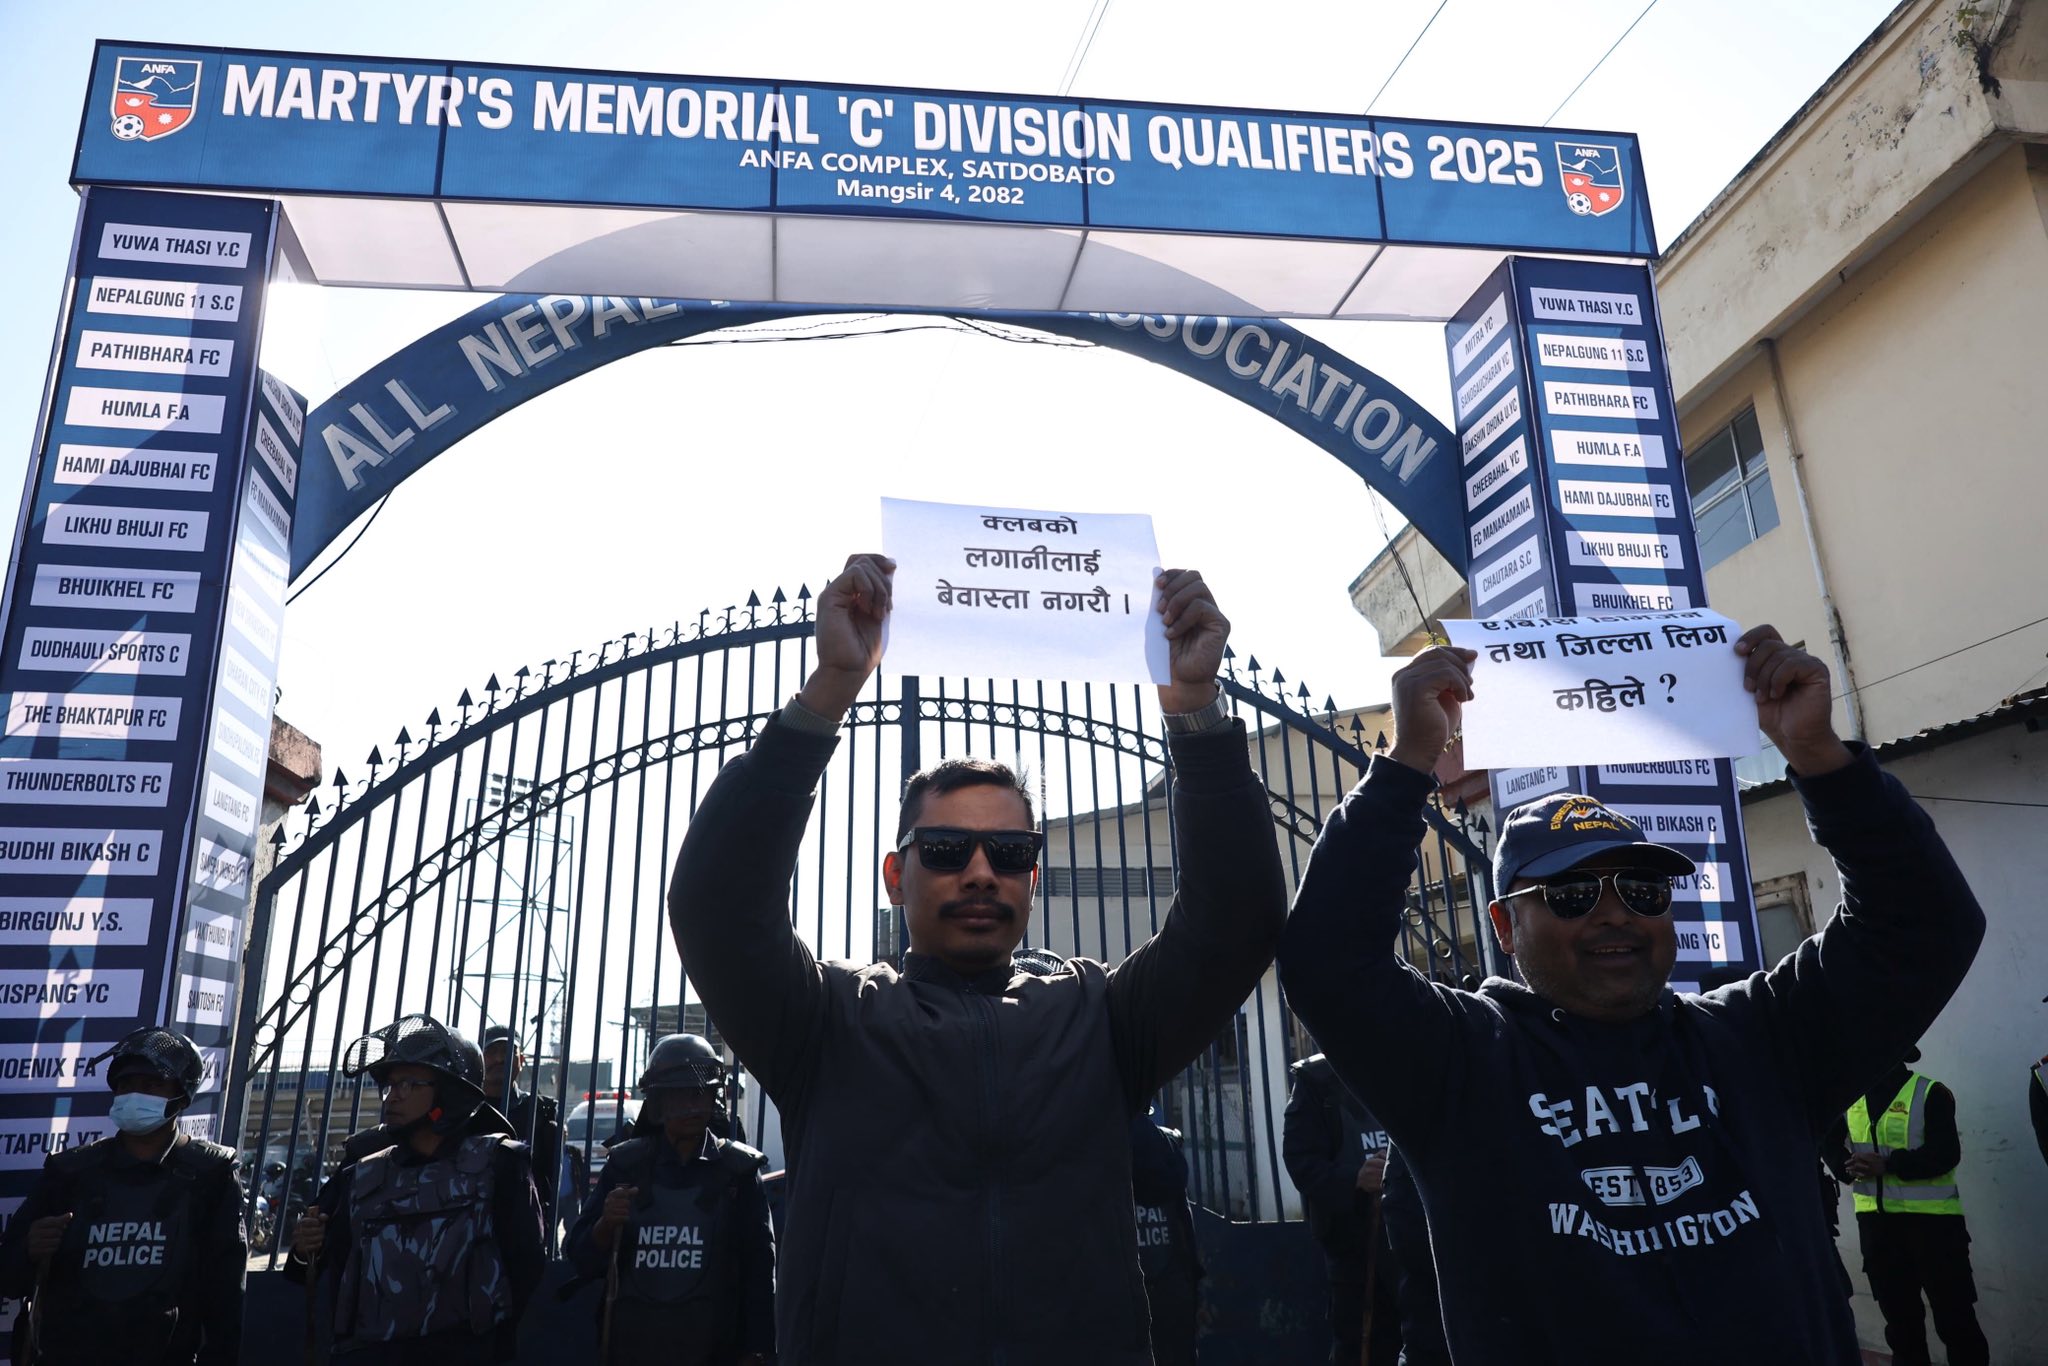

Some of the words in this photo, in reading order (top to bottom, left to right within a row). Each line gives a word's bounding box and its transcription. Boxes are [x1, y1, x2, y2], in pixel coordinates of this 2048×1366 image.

[141, 64, 176, 74] ANFA
[222, 63, 513, 130] MARTYR'S
[533, 80, 819, 145] MEMORIAL
[838, 96, 894, 148] 'C'
[913, 101, 1130, 162] DIVISION
[1147, 115, 1414, 178] QUALIFIERS
[1427, 135, 1543, 187] 2025
[1575, 147, 1600, 158] ANFA
[739, 149, 814, 171] ANFA
[821, 152, 955, 180] COMPLEX,
[962, 159, 1115, 185] SATDOBATO
[837, 179, 934, 203] Mangsir
[940, 185, 961, 204] 4,
[968, 185, 1025, 205] 2082
[113, 234, 159, 252] YUWA
[166, 237, 211, 255] THASI
[217, 241, 240, 257] Y.C
[96, 287, 185, 307] NEPALGUNG
[190, 293, 205, 309] 11
[211, 295, 235, 311] S.C
[1539, 297, 1575, 313] YUWA
[1577, 300, 1612, 315] THASI
[1615, 301, 1633, 316] Y.C
[1465, 327, 1485, 356] MITRA
[1484, 316, 1494, 335] YC
[91, 342, 193, 364] PATHIBHARA
[199, 348, 220, 366] FC
[1501, 351, 1510, 370] YC
[1544, 343, 1606, 360] NEPALGUNG
[1612, 348, 1623, 361] 11
[1627, 350, 1644, 362] S.C
[1096, 315, 1437, 483] OCIATION
[1555, 391, 1630, 408] PATHIBHARA
[1633, 396, 1648, 410] FC
[101, 400, 161, 419] HUMLA
[167, 404, 190, 421] F.A
[321, 378, 453, 492] ALL
[1577, 441, 1621, 456] HUMLA
[1624, 443, 1641, 457] F.A
[62, 456, 104, 474] HAMI
[109, 459, 185, 479] DAJUBHAI
[190, 463, 210, 480] FC
[1472, 461, 1509, 498] CHEEBAHAL
[1509, 450, 1520, 469] YC
[1564, 490, 1594, 505] HAMI
[1597, 491, 1652, 507] DAJUBHAI
[1655, 494, 1670, 508] FC
[64, 516, 110, 535] LIKHU
[116, 519, 163, 538] BHUJI
[168, 522, 188, 539] FC
[981, 514, 1077, 534] क्लबको
[1473, 533, 1482, 549] FC
[1483, 497, 1531, 540] MANAKAMANA
[964, 545, 1101, 575] लगानीलाई
[1581, 542, 1615, 557] LIKHU
[1619, 543, 1651, 558] BHUJI
[1654, 544, 1669, 559] FC
[1482, 560, 1518, 593] CHAUTARA
[1519, 550, 1532, 571] S.C
[58, 577, 146, 599] BHUIKHEL
[151, 582, 174, 600] FC
[936, 579, 1030, 609] बेवास्ता
[1535, 598, 1544, 615] YC
[1592, 594, 1654, 609] BHUIKHEL
[1657, 596, 1673, 611] FC
[31, 640, 103, 660] DUDHAULI
[108, 642, 164, 662] SPORTS
[169, 645, 179, 663] C
[1485, 640, 1547, 663] तथा
[1556, 632, 1653, 657] जिल्ला
[1662, 624, 1728, 649] लिग
[1553, 676, 1646, 713] कहिले
[1659, 673, 1677, 703] ?
[25, 705, 52, 723] THE
[56, 707, 143, 727] BHAKTAPUR
[148, 709, 167, 728] FC
[1605, 760, 1693, 775] THUNDERBOLTS
[1696, 759, 1710, 775] FC
[7, 771, 136, 793] THUNDERBOLTS
[141, 774, 162, 794] FC
[1506, 769, 1546, 795] LANGTANG
[1547, 765, 1558, 782] FC
[1573, 821, 1619, 831] NEPAL
[1658, 815, 1704, 832] BIKASH
[1707, 816, 1716, 832] C
[61, 842, 131, 861] BIKASH
[137, 843, 150, 862] C
[1692, 874, 1715, 890] Y.S.
[0, 911, 84, 931] BIRGUNJ
[92, 912, 123, 931] Y.S.
[1704, 933, 1720, 949] YC
[85, 984, 109, 1004] YC
[216, 995, 224, 1013] FC
[73, 1057, 96, 1077] FA
[0, 1132, 69, 1155] TAPUR
[1645, 1165, 1694, 1197] 853
[1136, 1205, 1167, 1224] PAL
[88, 1221, 167, 1244] NEPAL
[638, 1225, 703, 1245] NEPAL
[1136, 1227, 1170, 1247] LICE
[83, 1245, 164, 1269] POLICE
[635, 1250, 702, 1269] POLICE
